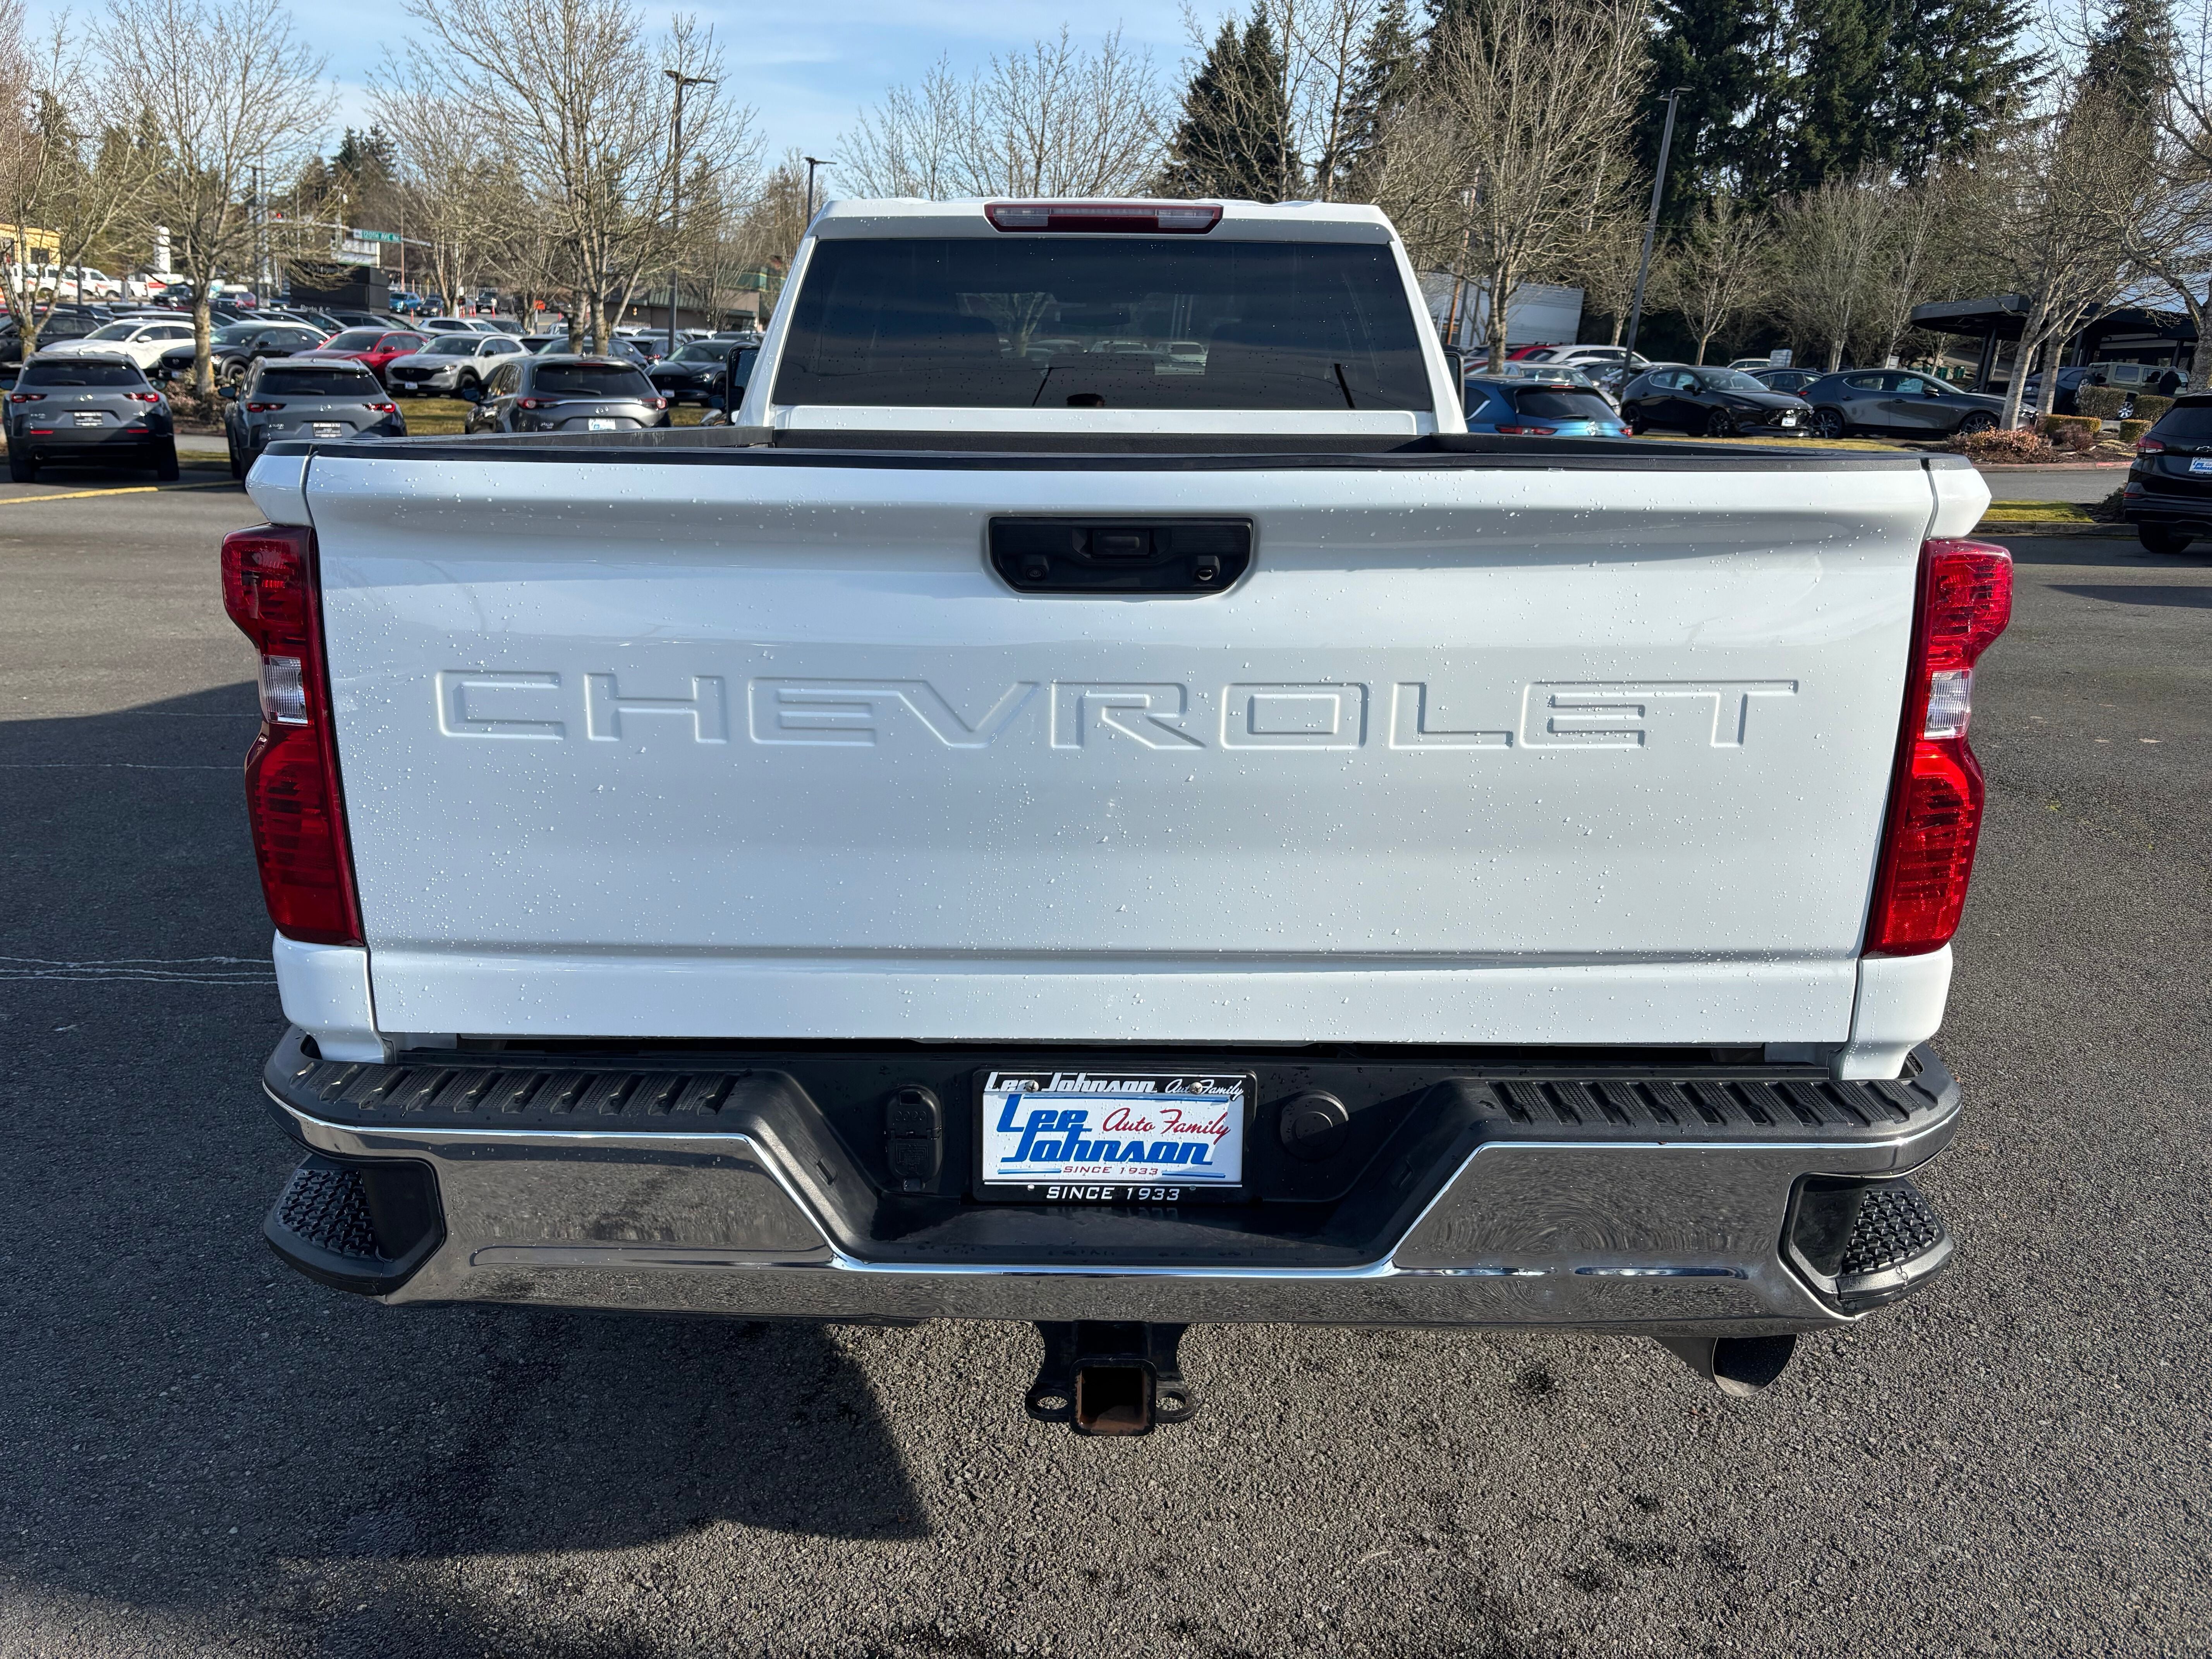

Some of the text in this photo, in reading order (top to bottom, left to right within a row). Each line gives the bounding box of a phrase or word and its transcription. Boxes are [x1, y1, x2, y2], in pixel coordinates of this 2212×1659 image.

[436, 670, 1799, 750] CHEVROLET
[1041, 1072, 1158, 1093] Johnson
[1165, 1079, 1196, 1093] Aut
[1200, 1079, 1244, 1101] Family
[996, 1094, 1231, 1145] Lee Auto Family
[1001, 1128, 1213, 1166] Johnson
[1063, 1165, 1159, 1176] SINCE 1933
[1046, 1185, 1180, 1201] SINCE 1933
